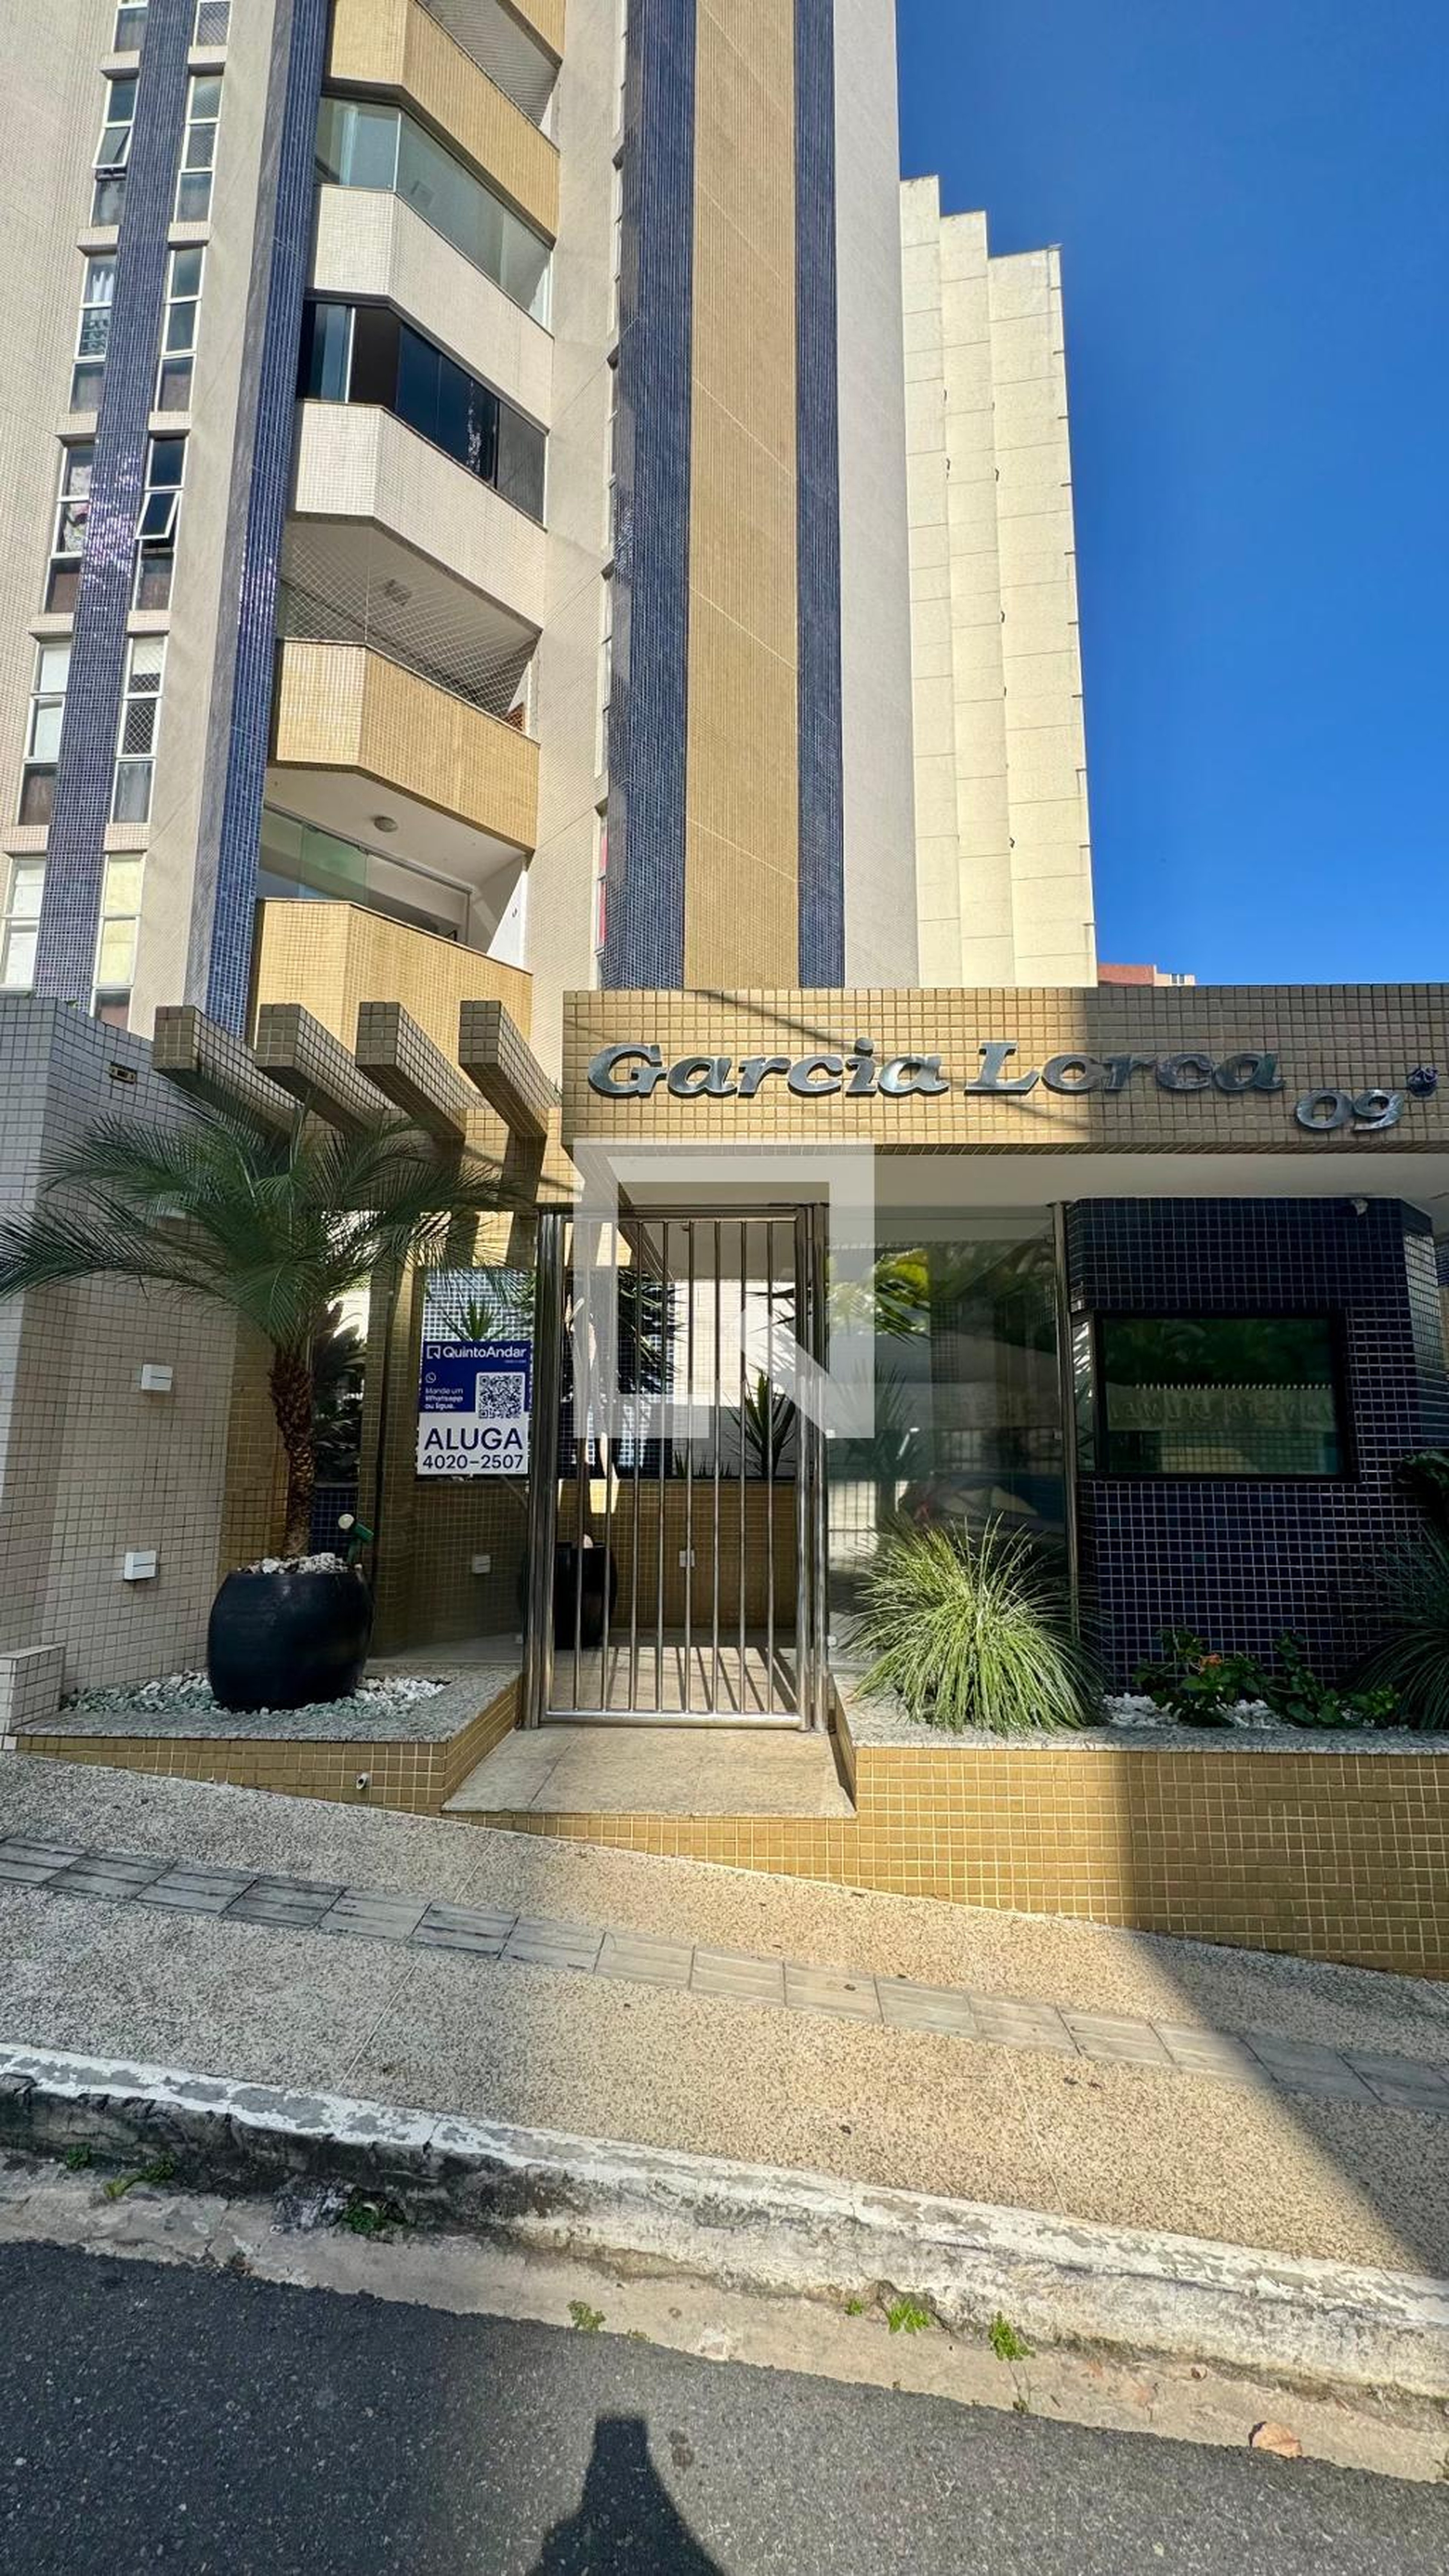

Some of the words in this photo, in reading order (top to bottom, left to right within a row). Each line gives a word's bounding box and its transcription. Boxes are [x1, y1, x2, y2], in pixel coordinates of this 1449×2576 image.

[588, 1037, 949, 1098] Garcia
[963, 1041, 1286, 1096] Lorca
[1293, 1089, 1405, 1133] 09
[443, 1346, 527, 1359] QuintoAndar
[424, 1428, 523, 1450] ALUGA
[423, 1454, 523, 1469] 4020-2507
